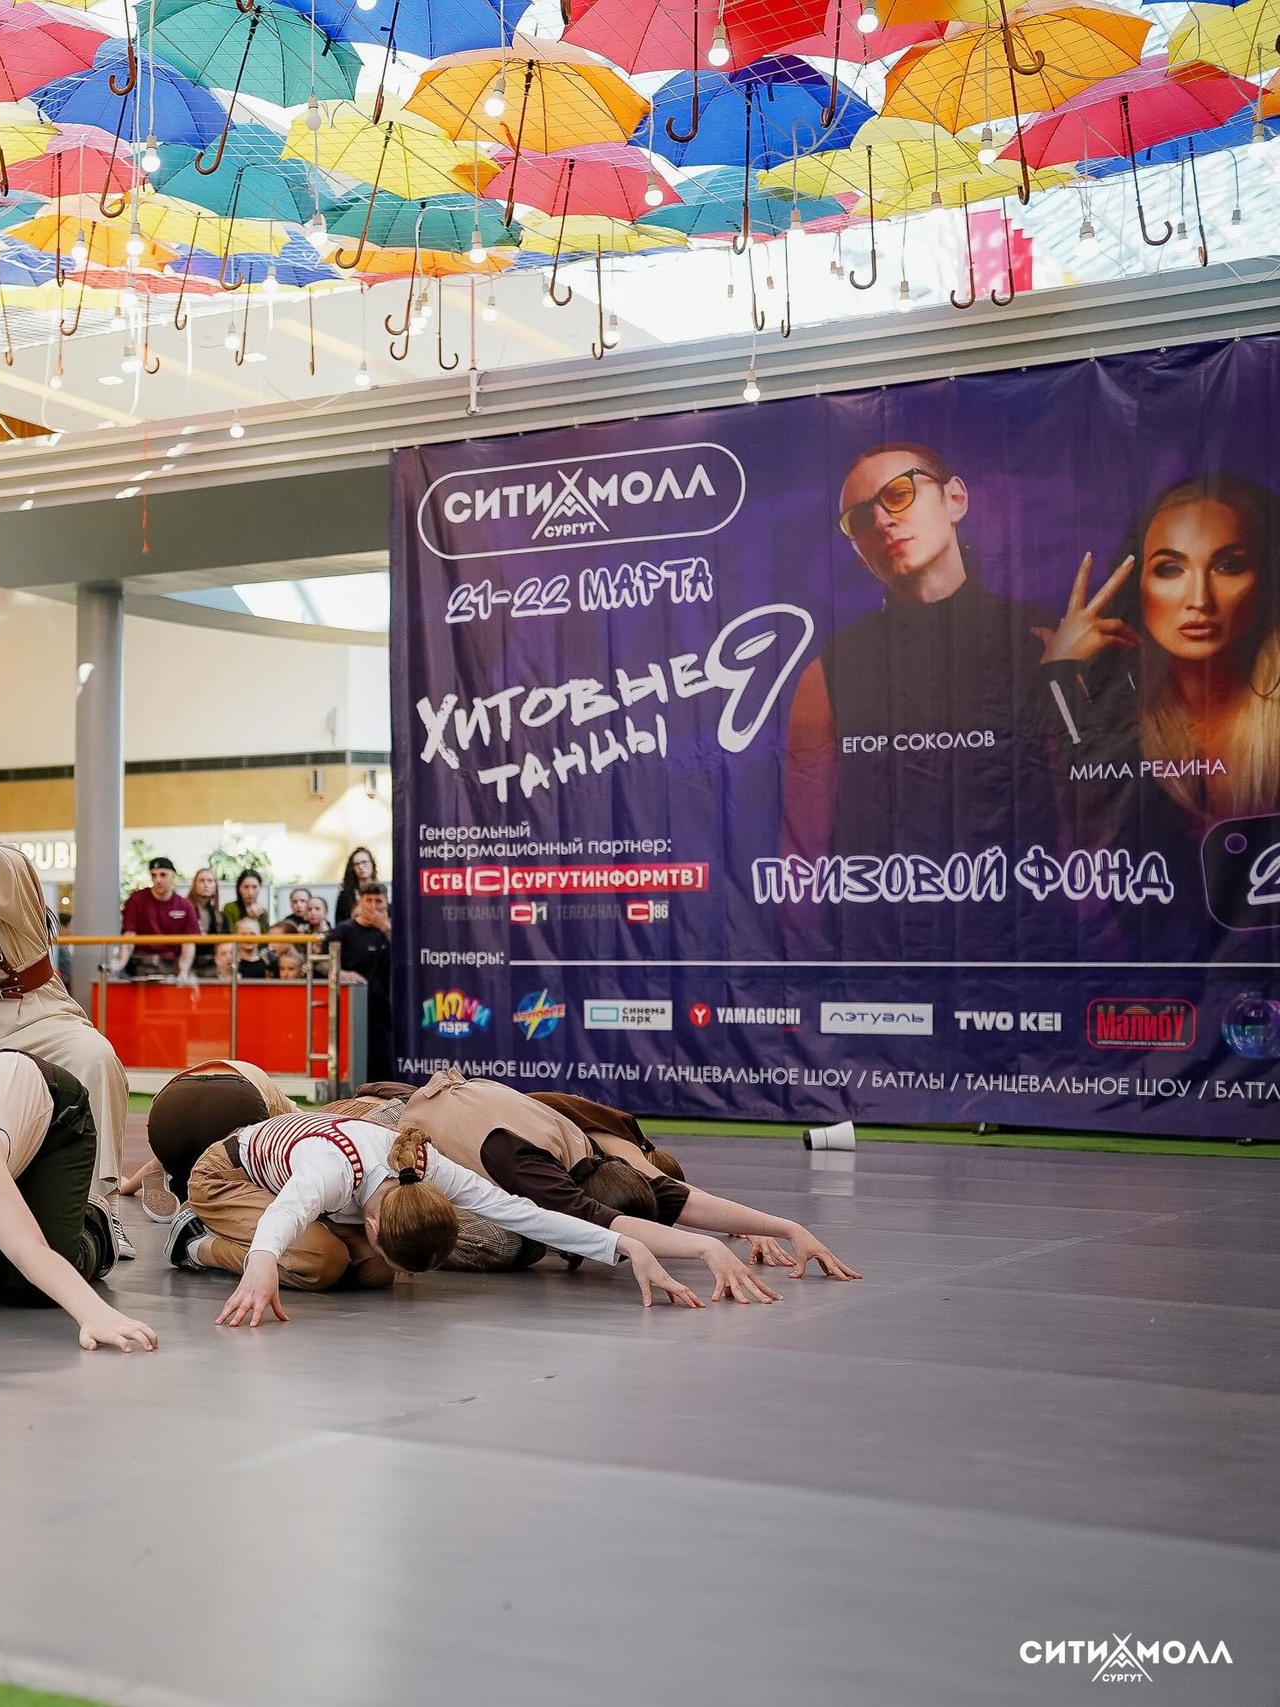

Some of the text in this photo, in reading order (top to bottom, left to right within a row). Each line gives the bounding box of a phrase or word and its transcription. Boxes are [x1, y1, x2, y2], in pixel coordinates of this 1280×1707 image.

[443, 463, 716, 524] СИТИ МОЛЛ
[543, 521, 597, 539] СУРГУТ
[445, 557, 714, 624] 21-22 МАРТА
[416, 653, 709, 770] ХИТОВЫЕ
[842, 730, 996, 754] ЕГОР СОКОЛОВ
[478, 715, 668, 803] ТАНЦЫ
[1070, 758, 1227, 782] МИЛА РЕДИНА
[419, 821, 531, 842] Генеральный
[420, 837, 672, 860] информационный партнер:
[751, 845, 1175, 905] ПРИЗОВОЙ ФОНД
[420, 948, 505, 968] Партнеры:
[622, 1007, 666, 1016] синема
[622, 1016, 652, 1026] парк
[716, 1007, 801, 1025] YAMAGUCHI
[954, 1010, 1062, 1032] TWO KEI
[439, 1021, 470, 1036] парк
[520, 1060, 562, 1079] ШОУ
[578, 1063, 640, 1081] БАТТЛЫ
[657, 1064, 799, 1086] ТАНЦЕВАЛЬНОЕ
[803, 1067, 852, 1086] ШОУ
[871, 1070, 945, 1090] БАТТЛЫ
[965, 1073, 1129, 1096] ТАНЦЕВАЛЬНОЕ
[1136, 1077, 1191, 1097] ШОУ
